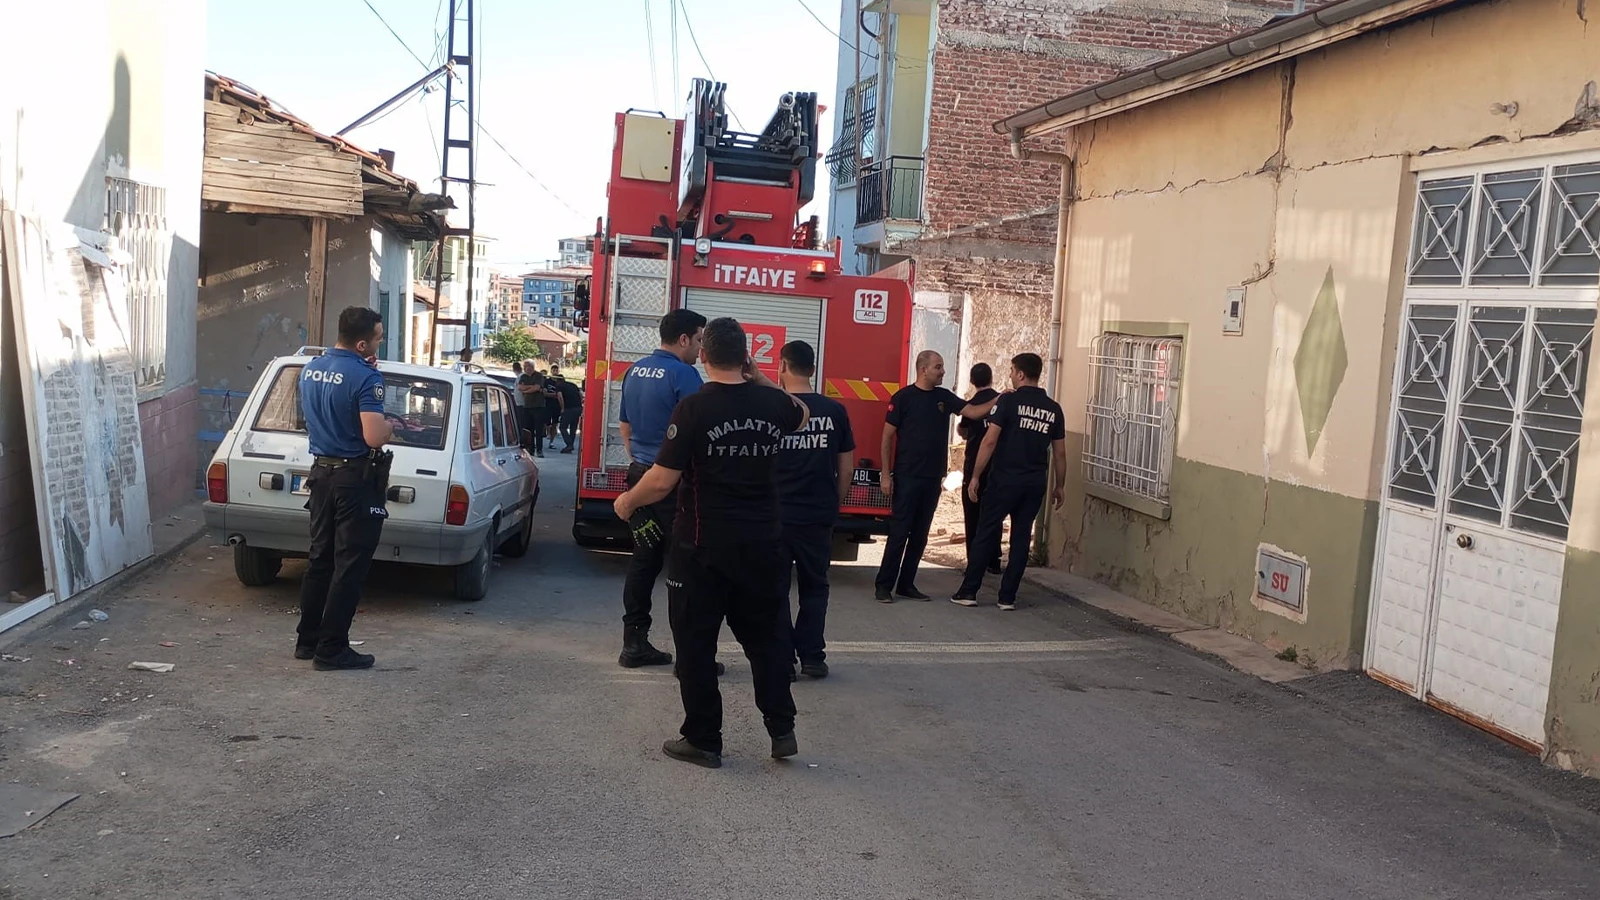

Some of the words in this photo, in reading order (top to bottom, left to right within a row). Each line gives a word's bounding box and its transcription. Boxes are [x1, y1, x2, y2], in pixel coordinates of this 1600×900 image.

[860, 292, 883, 310] 112
[745, 332, 774, 364] 12
[1018, 405, 1056, 424] MALATYA
[706, 418, 782, 442] MALATYA
[853, 469, 872, 482] ABL
[1271, 571, 1290, 593] SU
